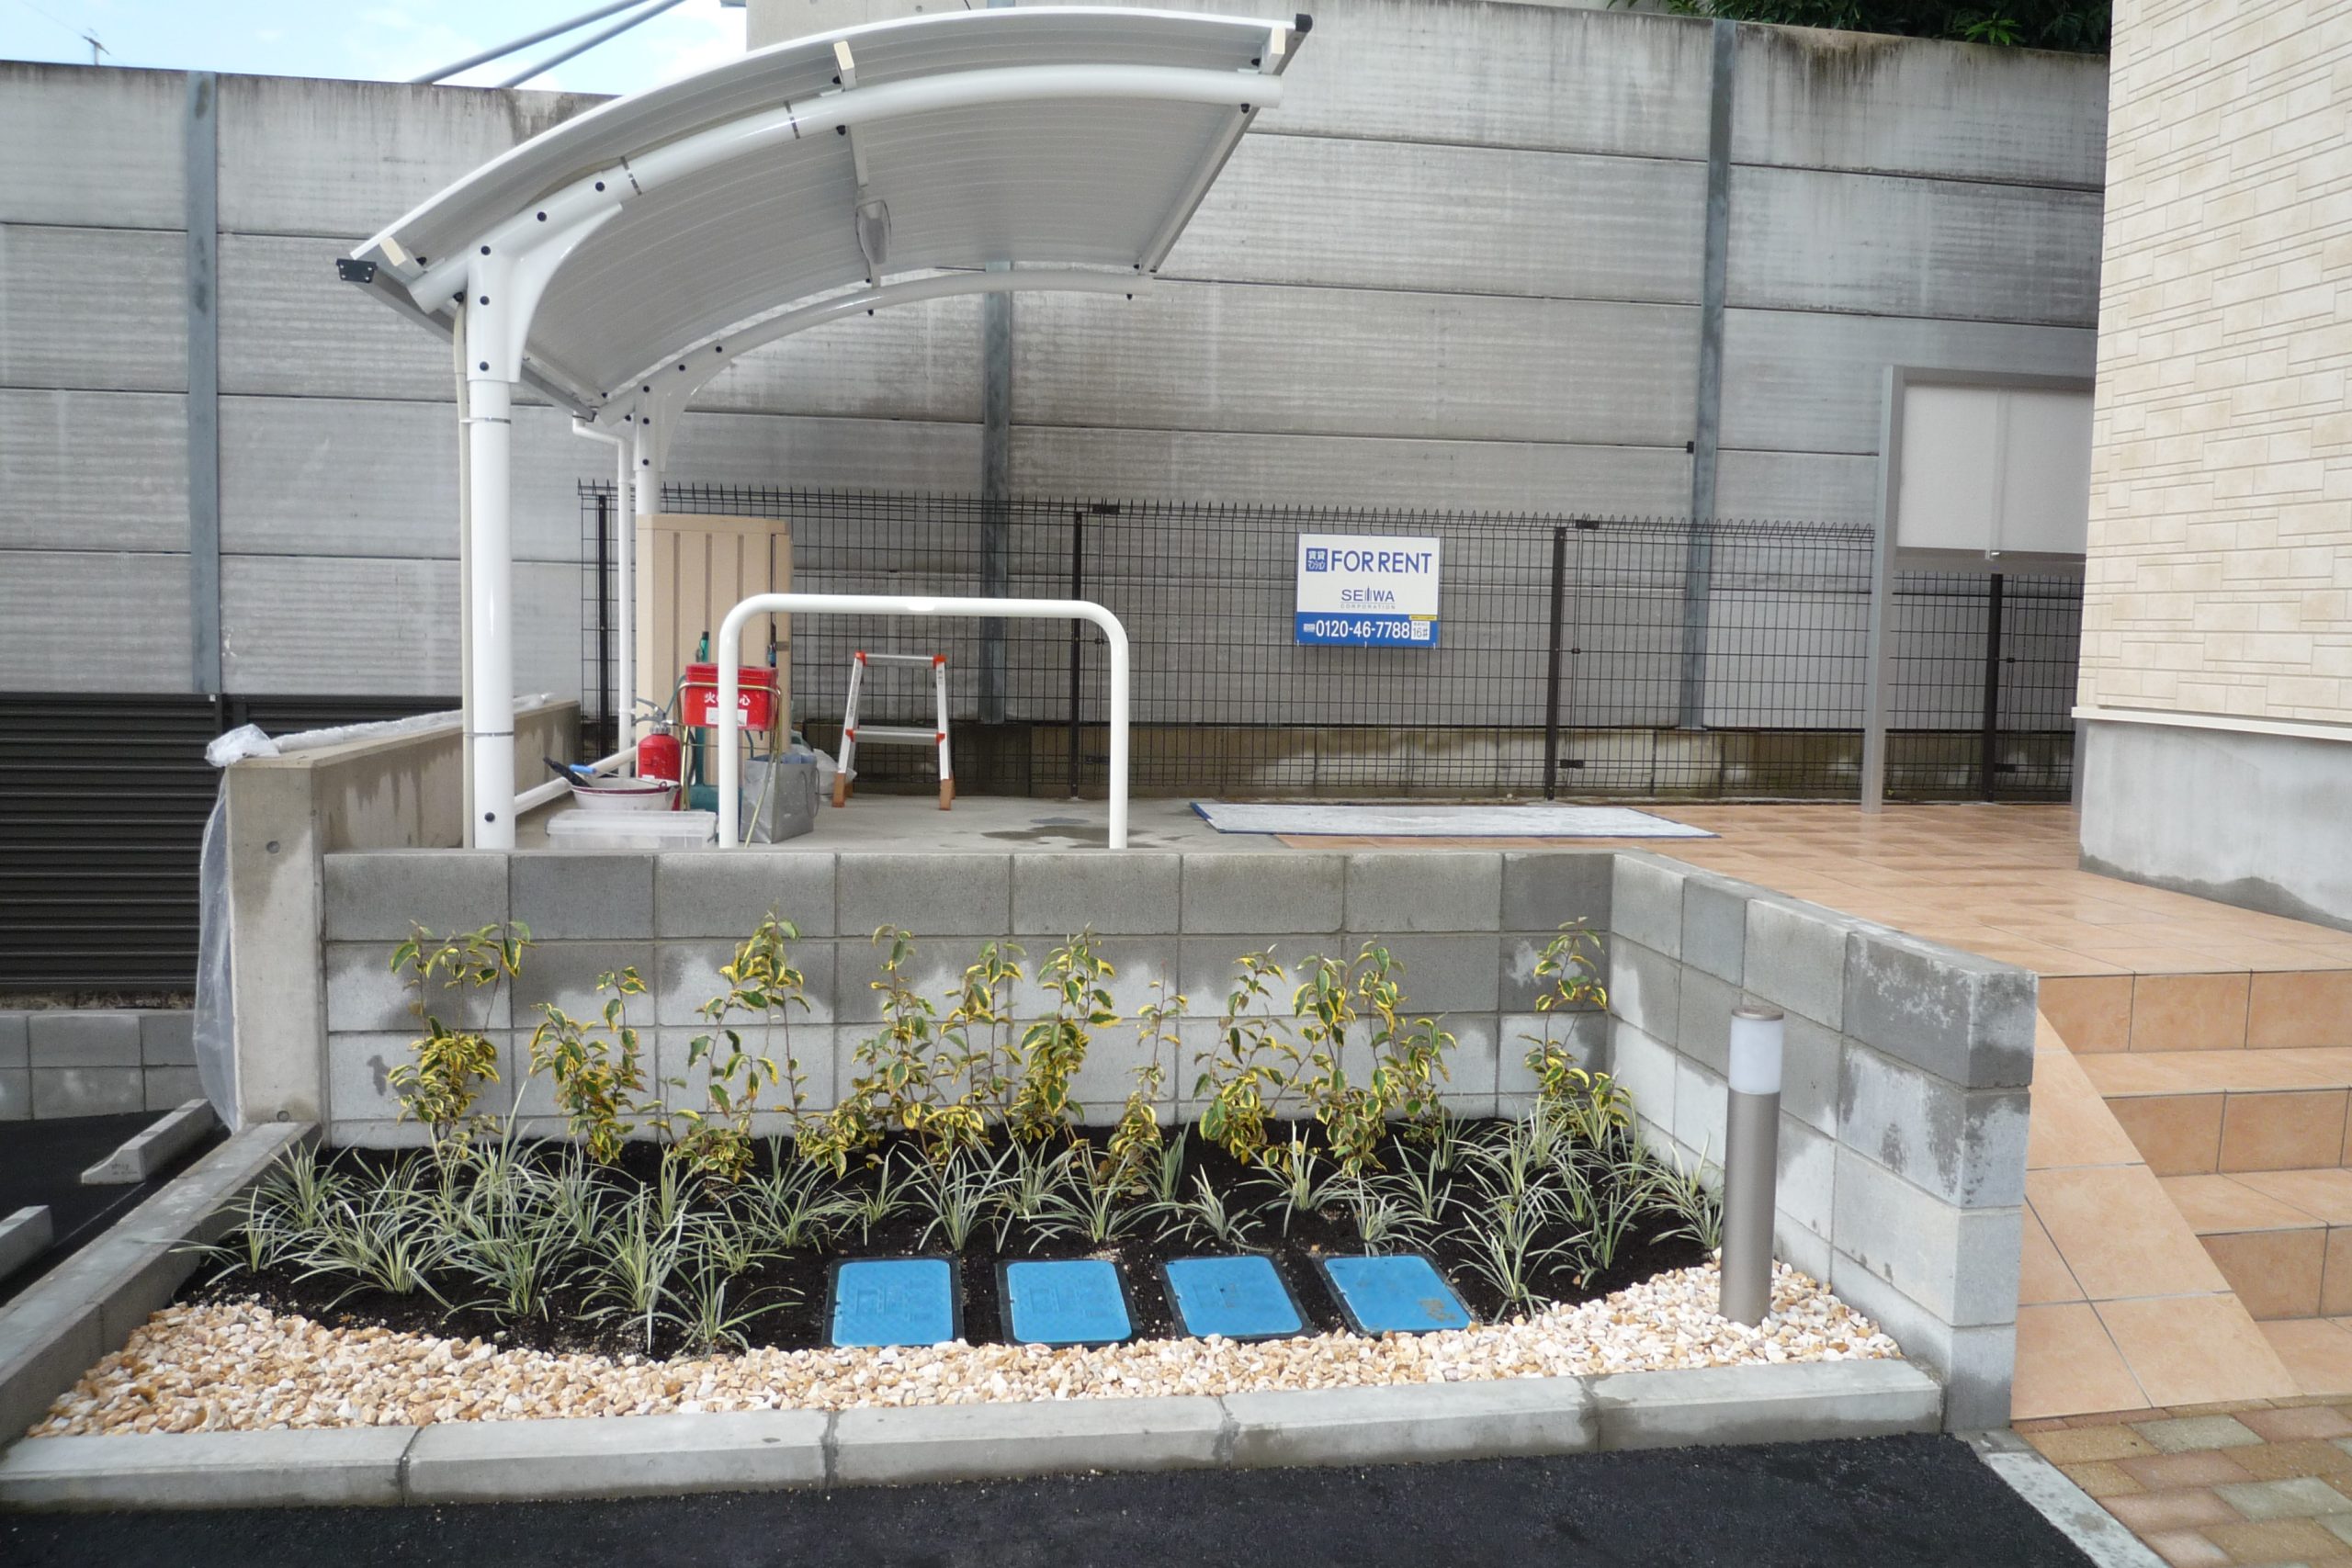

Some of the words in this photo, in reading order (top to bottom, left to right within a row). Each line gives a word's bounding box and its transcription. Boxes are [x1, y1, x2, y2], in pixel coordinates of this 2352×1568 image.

[1331, 550, 1374, 572] FOR
[1378, 551, 1432, 573] RENT
[1341, 585, 1395, 603] SEIWA
[1316, 620, 1410, 638] 0120-46-7788
[704, 692, 751, 706] 火心
